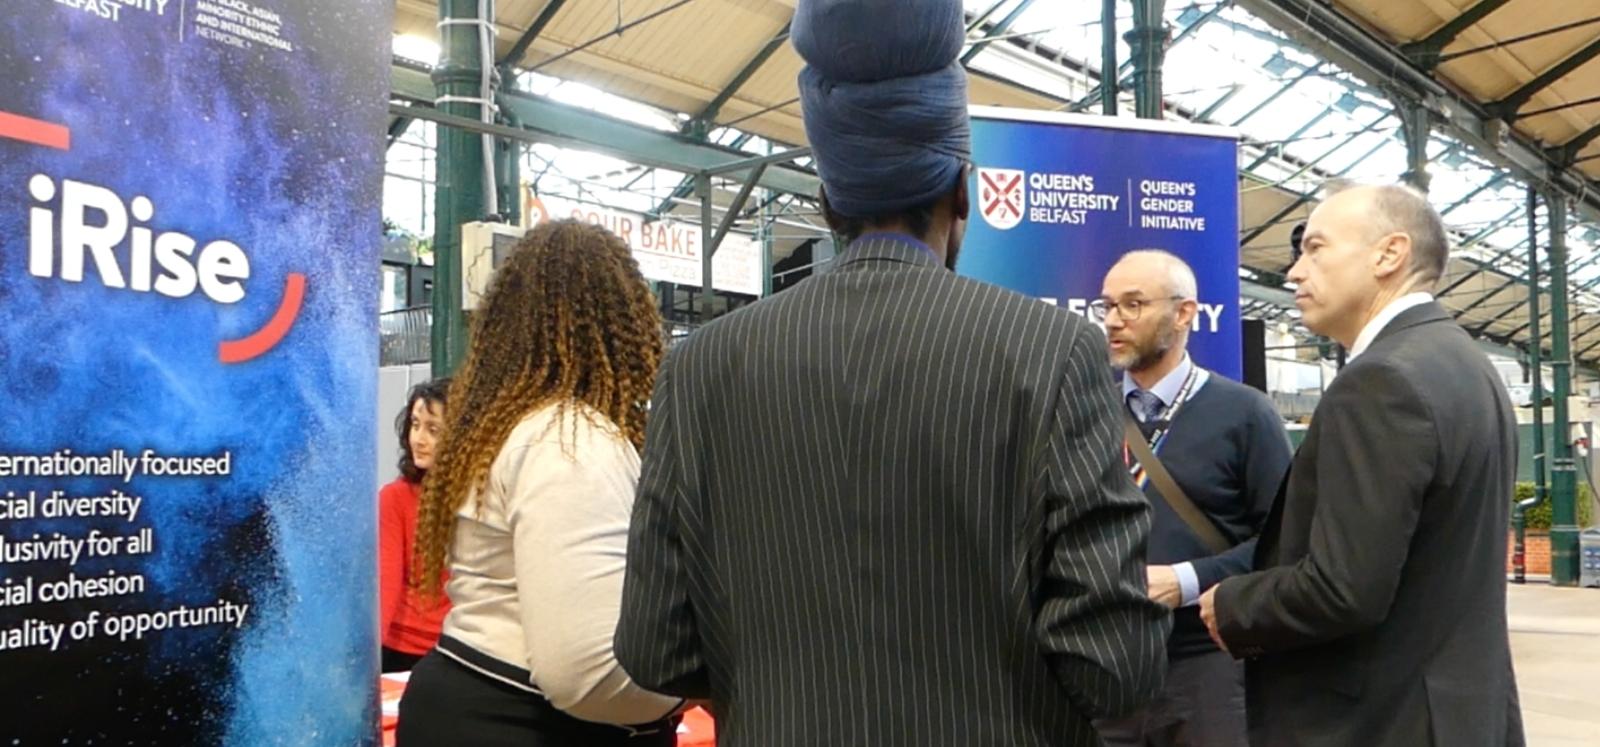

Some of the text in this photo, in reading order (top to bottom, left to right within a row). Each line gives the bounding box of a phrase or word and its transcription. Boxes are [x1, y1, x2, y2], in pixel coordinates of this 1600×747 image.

[196, 13, 293, 51] AND INTERNATIONAL
[1029, 172, 1094, 192] QUEEN'S
[1140, 180, 1196, 196] QUEEN'S
[1029, 191, 1120, 212] UNIVERSITY
[1141, 198, 1194, 213] GENDER
[1029, 209, 1088, 225] BELFAST
[1141, 216, 1205, 232] INITIATIVE
[29, 174, 250, 304] iRise
[641, 221, 697, 257] BAKE
[0, 450, 231, 483] ernationally focused
[42, 490, 142, 522] diversity
[88, 530, 123, 557] for
[127, 528, 152, 555] all
[38, 569, 145, 602] cohesion
[70, 611, 100, 639] of
[104, 599, 249, 642] opportunity
